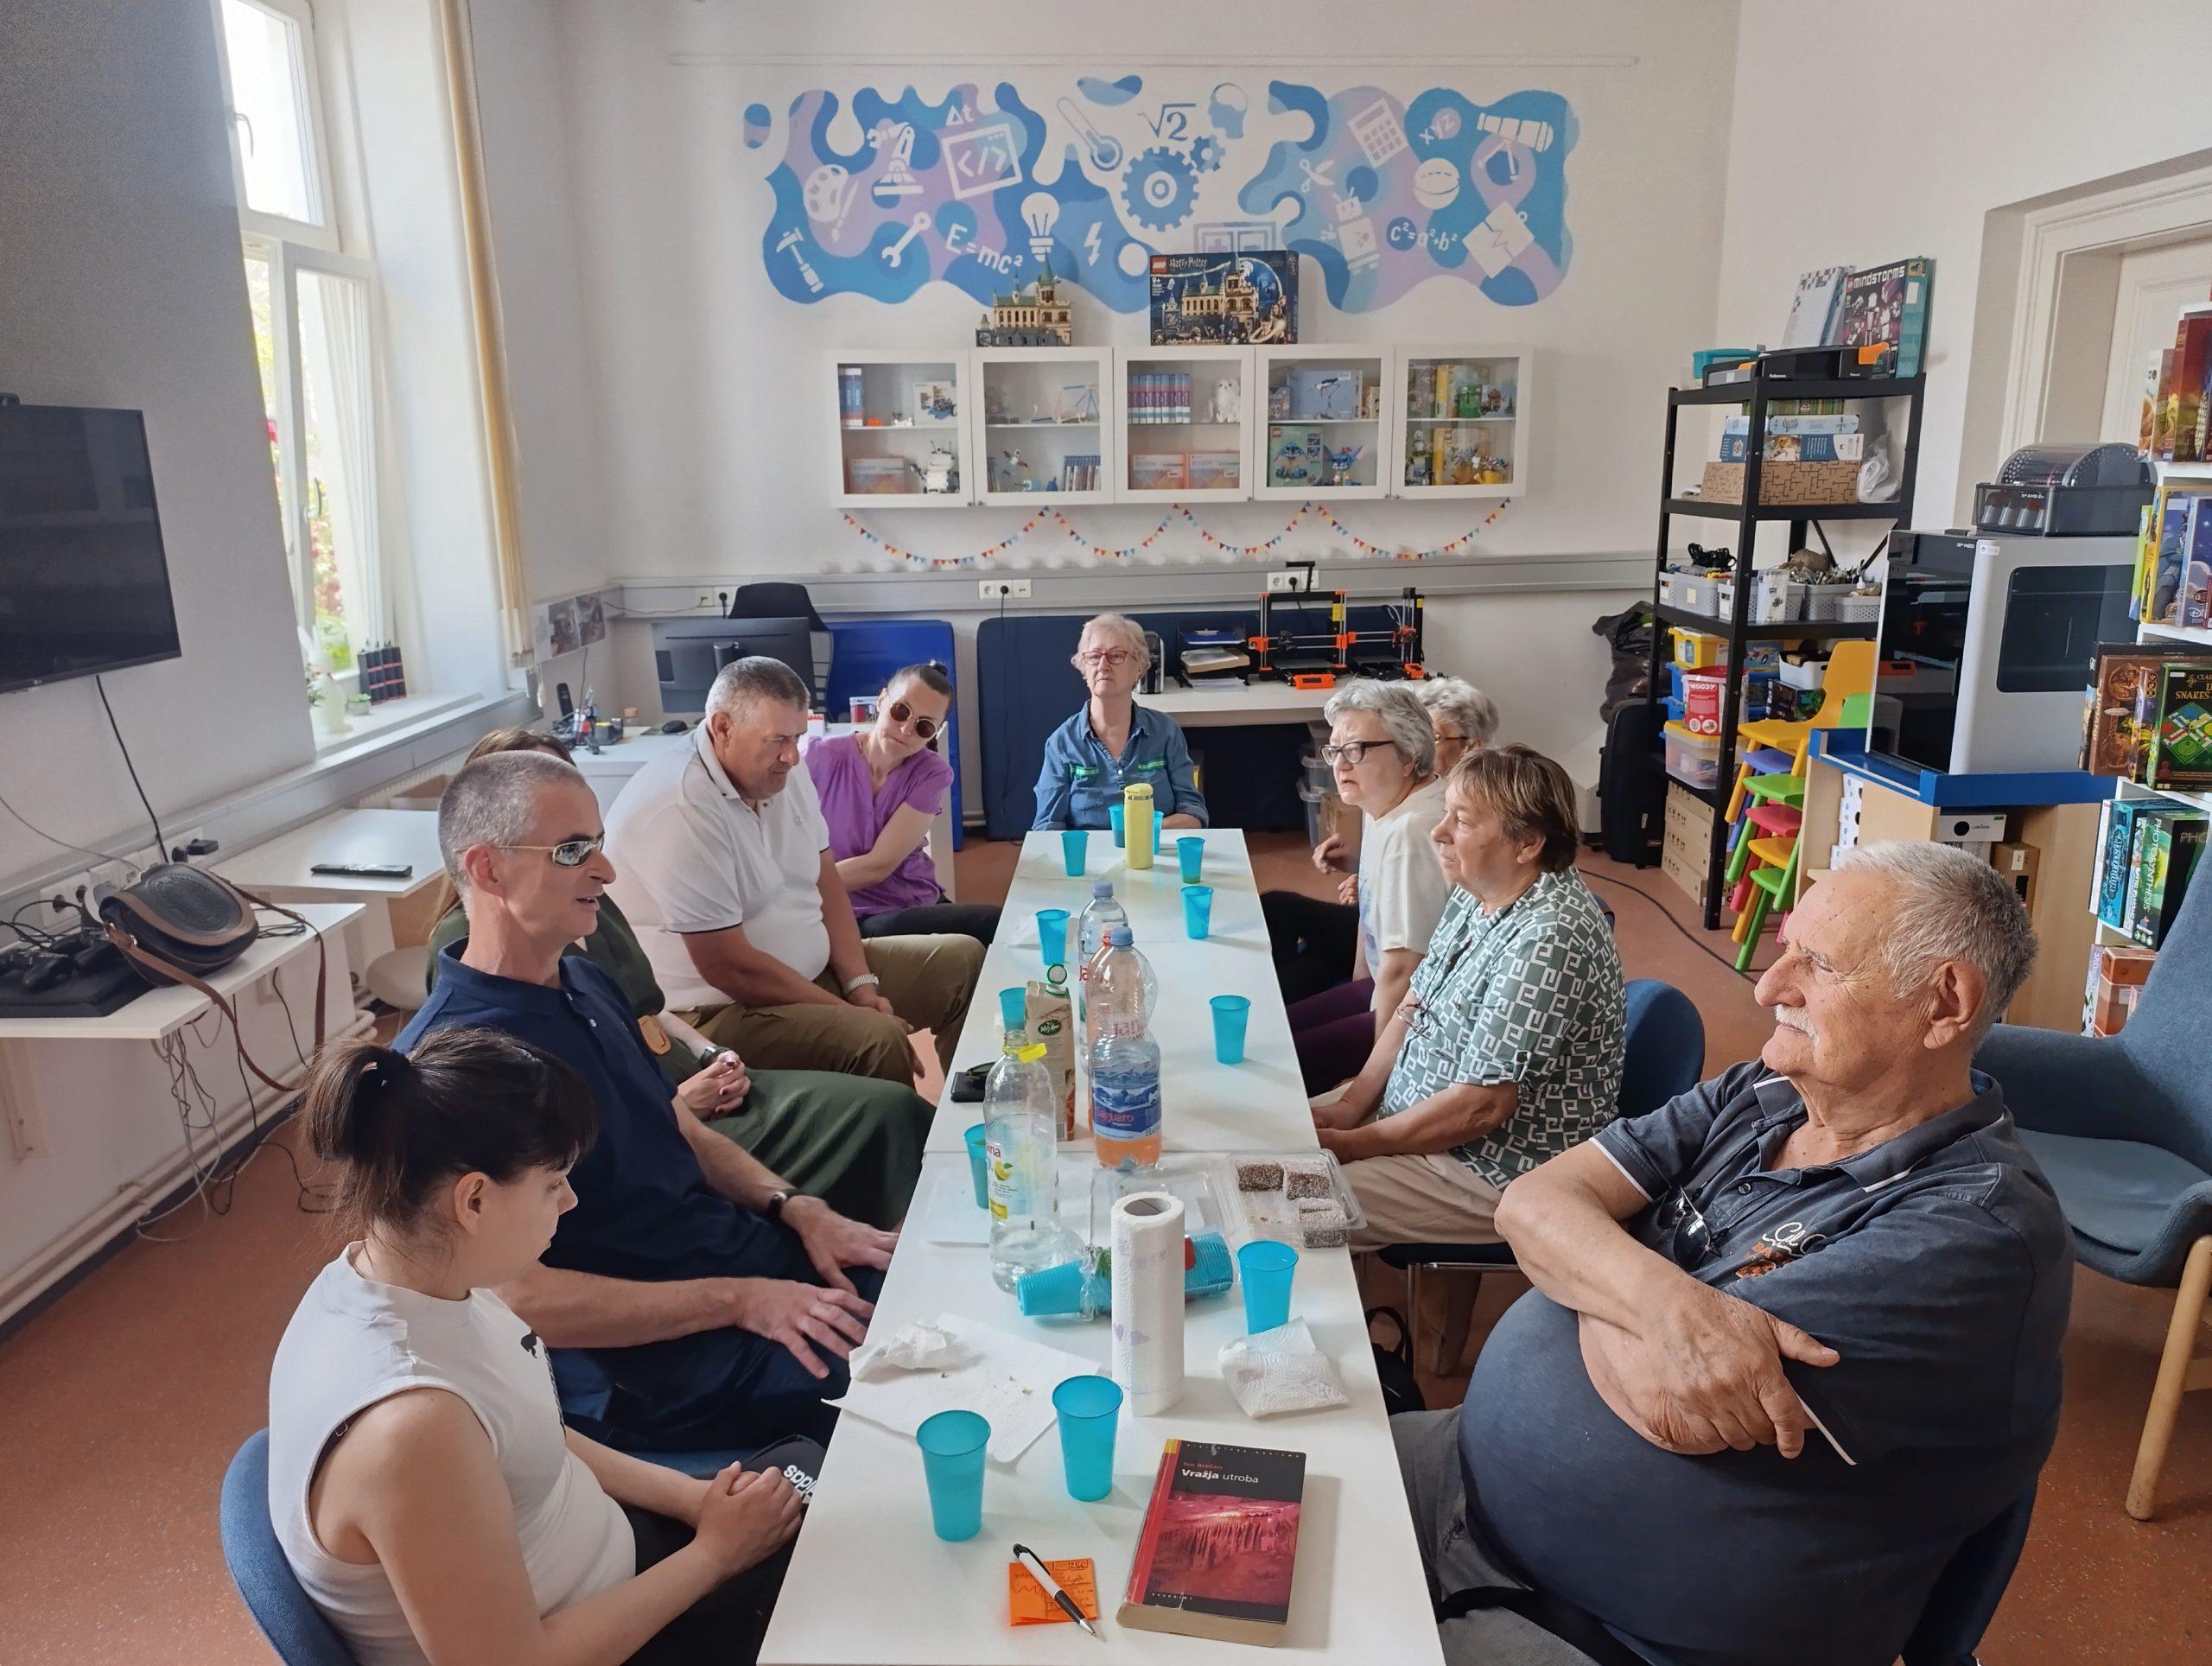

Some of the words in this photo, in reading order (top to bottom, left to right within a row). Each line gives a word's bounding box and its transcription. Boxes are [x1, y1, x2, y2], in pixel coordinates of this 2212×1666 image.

[2175, 690, 2209, 700] SNAKES
[2143, 817, 2162, 910] PHOTOSYNTHESIS
[987, 1142, 1001, 1158] ana
[1182, 1468, 1219, 1480] Vražja
[1223, 1472, 1259, 1484] utroba
